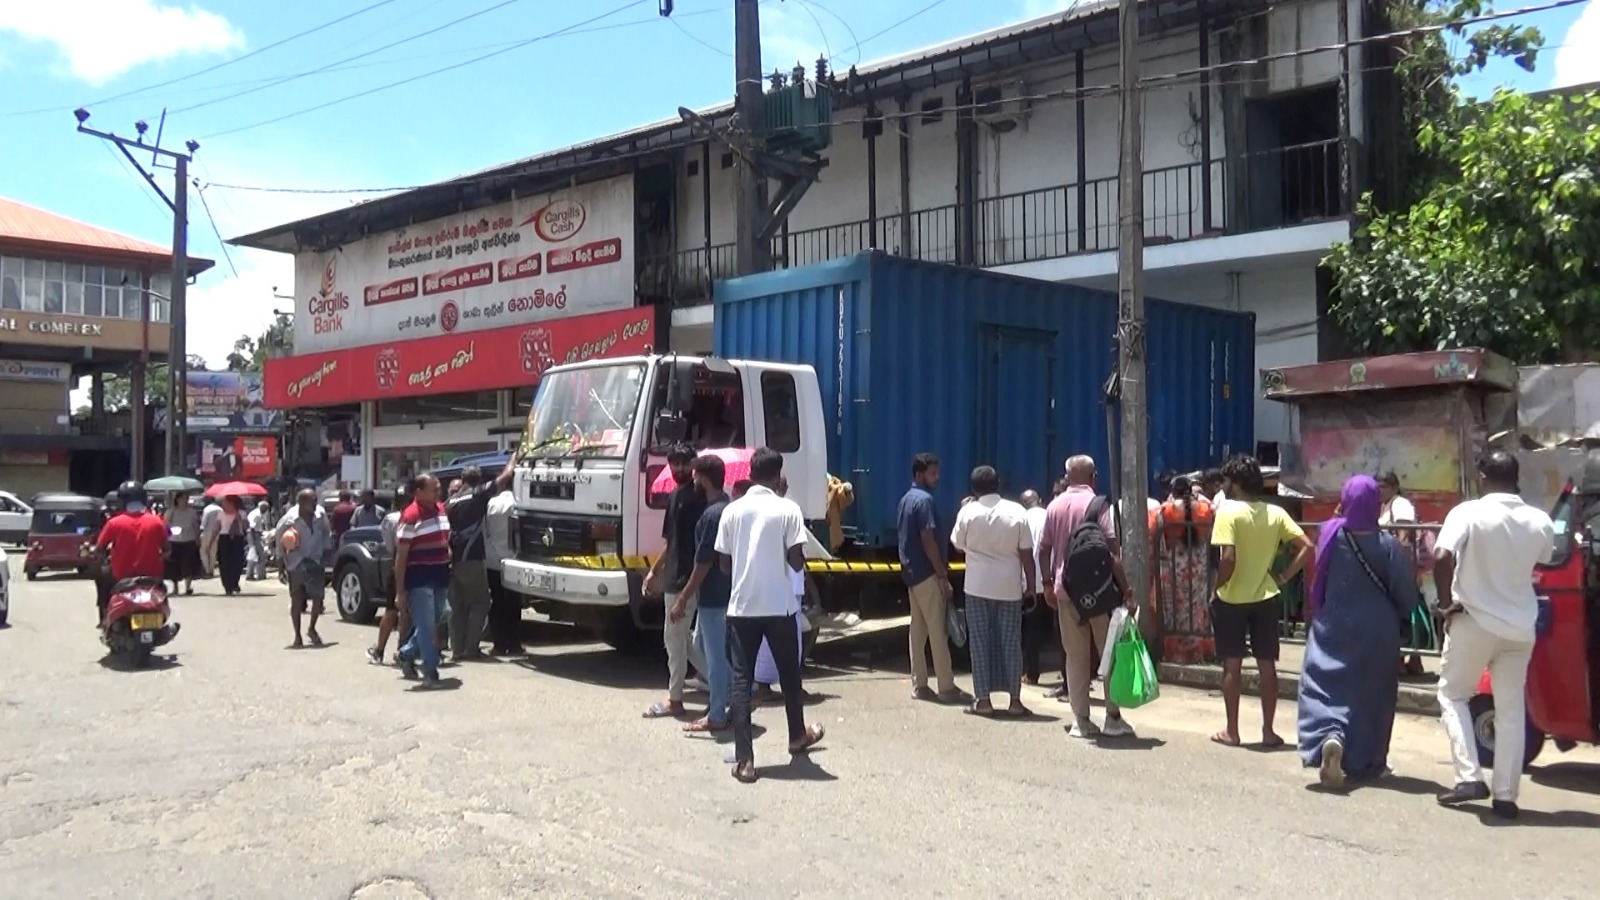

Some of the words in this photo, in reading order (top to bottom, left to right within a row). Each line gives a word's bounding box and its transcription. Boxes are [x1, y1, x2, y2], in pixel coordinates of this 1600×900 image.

[545, 206, 580, 224] Cargills
[550, 221, 575, 235] Cash
[309, 292, 349, 316] Cargills
[508, 284, 567, 312] නොමිලේ
[28, 320, 103, 337] COMPLEX
[314, 314, 342, 334] Bank
